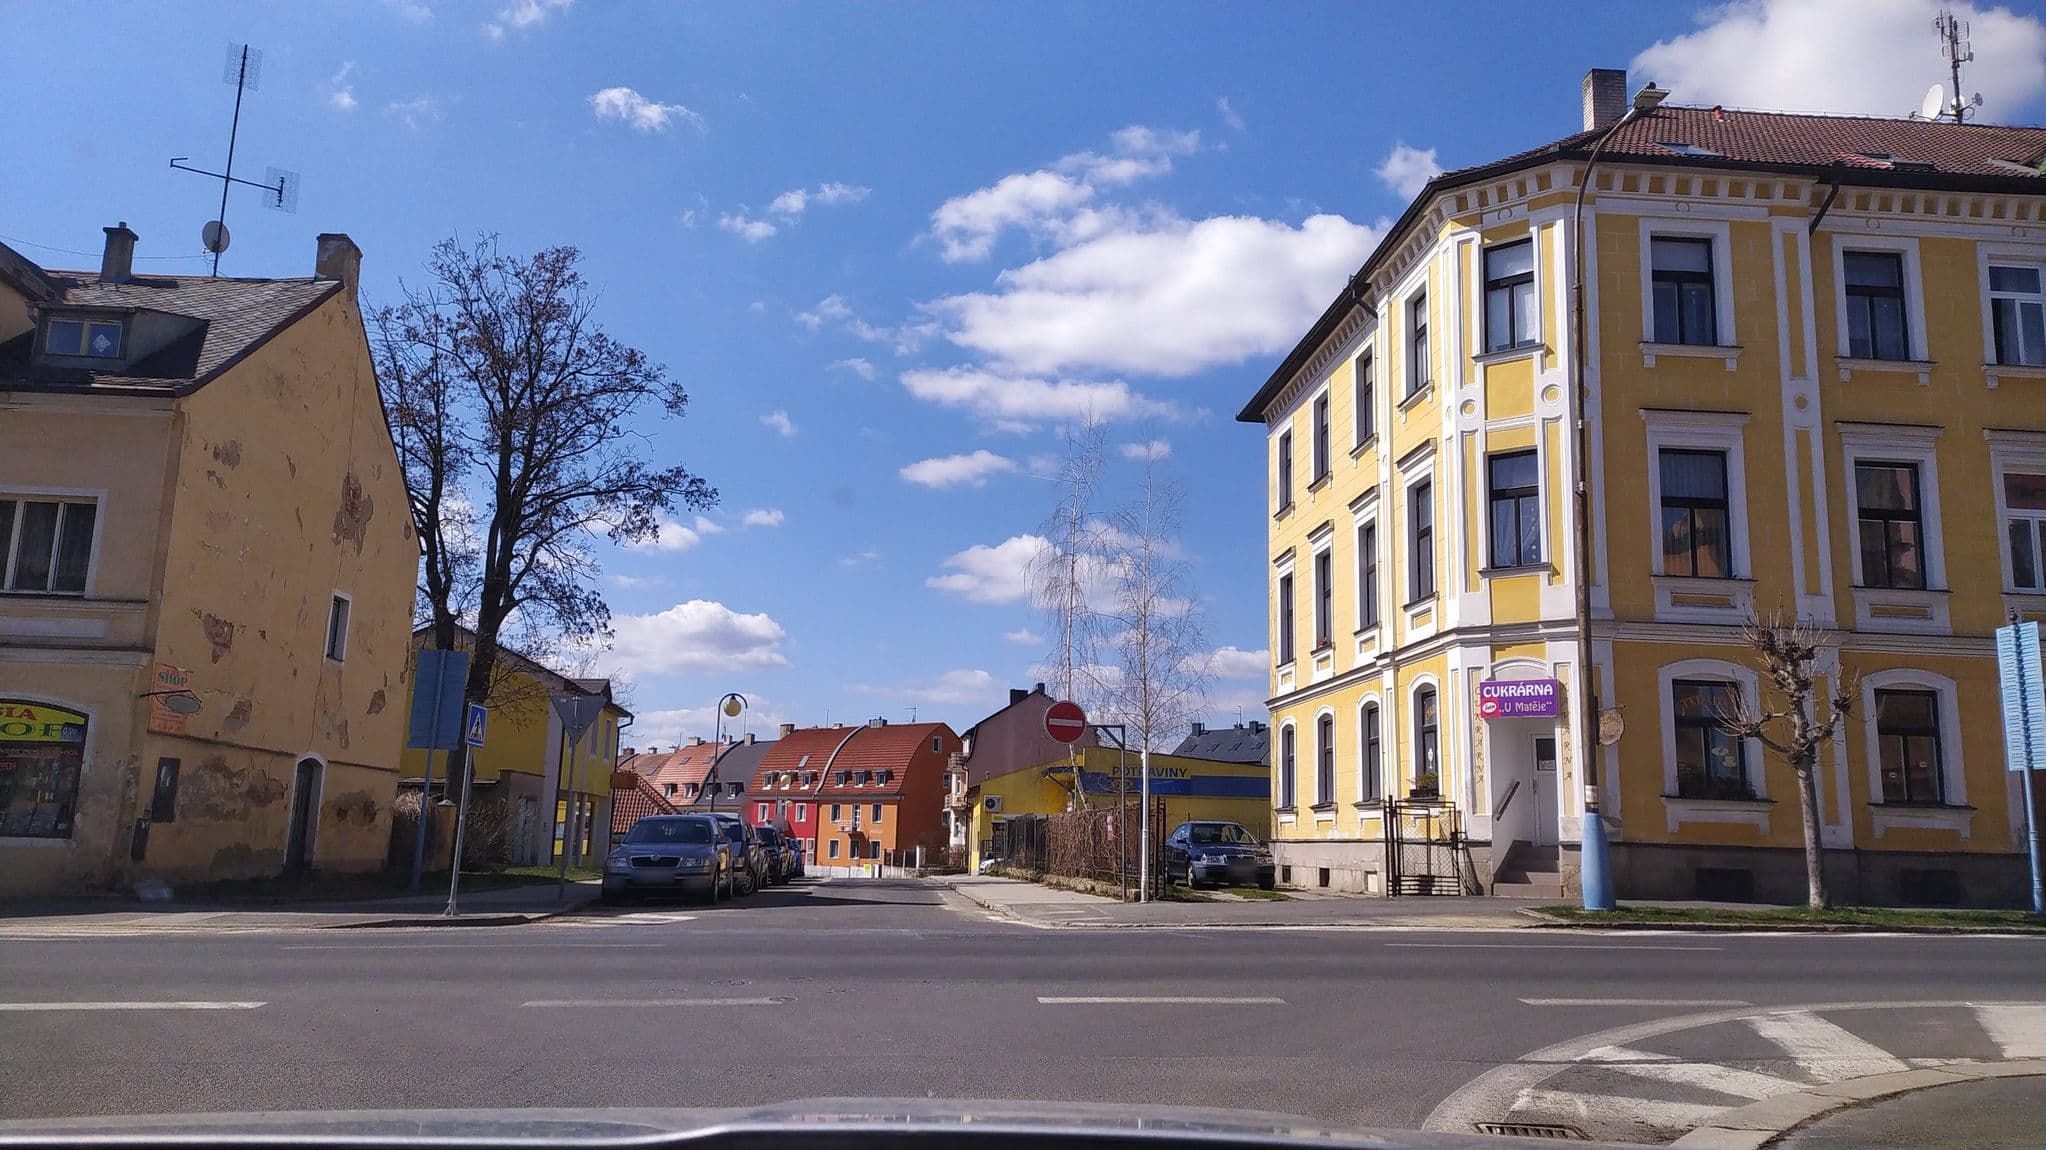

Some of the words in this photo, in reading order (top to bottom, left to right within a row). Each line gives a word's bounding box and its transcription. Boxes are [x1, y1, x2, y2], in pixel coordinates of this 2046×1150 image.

[159, 672, 187, 685] SHOP
[1483, 682, 1553, 698] CUKRÁRNA
[0, 707, 38, 720] IA
